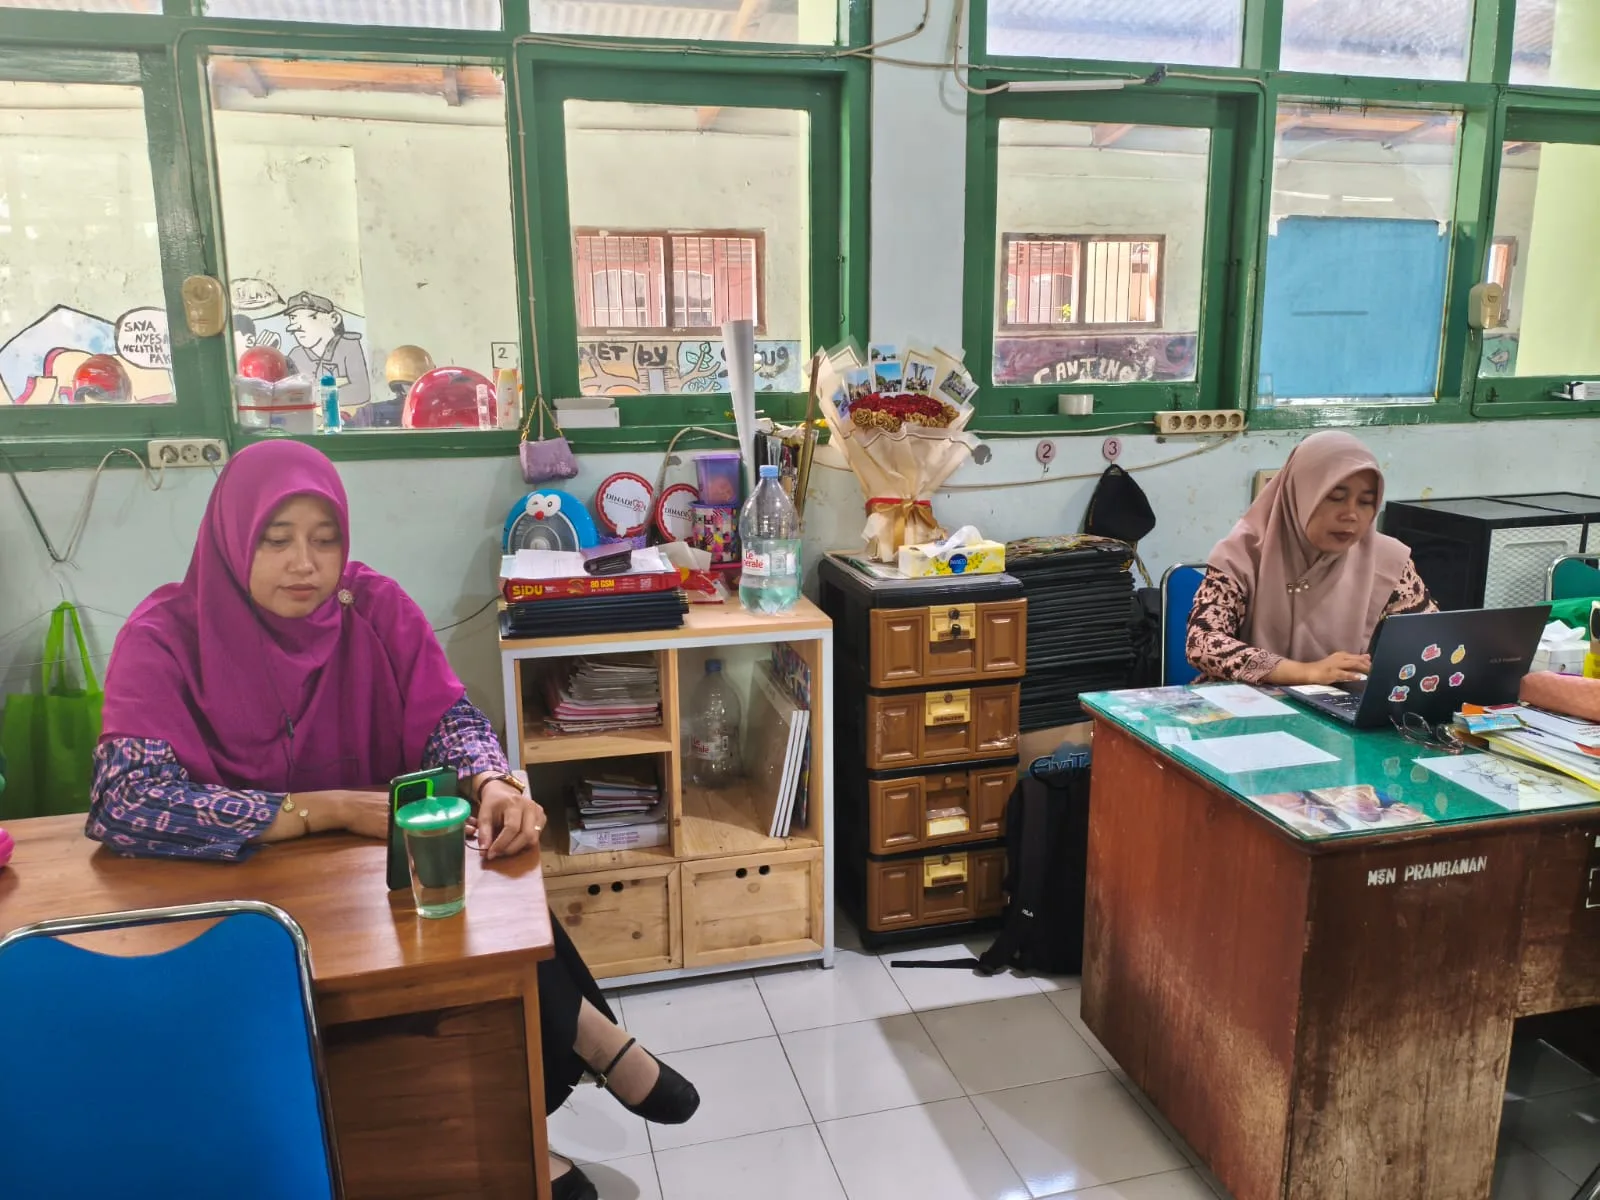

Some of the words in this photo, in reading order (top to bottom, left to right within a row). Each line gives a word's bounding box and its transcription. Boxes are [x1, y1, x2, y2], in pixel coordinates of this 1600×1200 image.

[124, 320, 156, 332] SAYA
[1042, 444, 1052, 459] 2
[1108, 441, 1118, 456] 3
